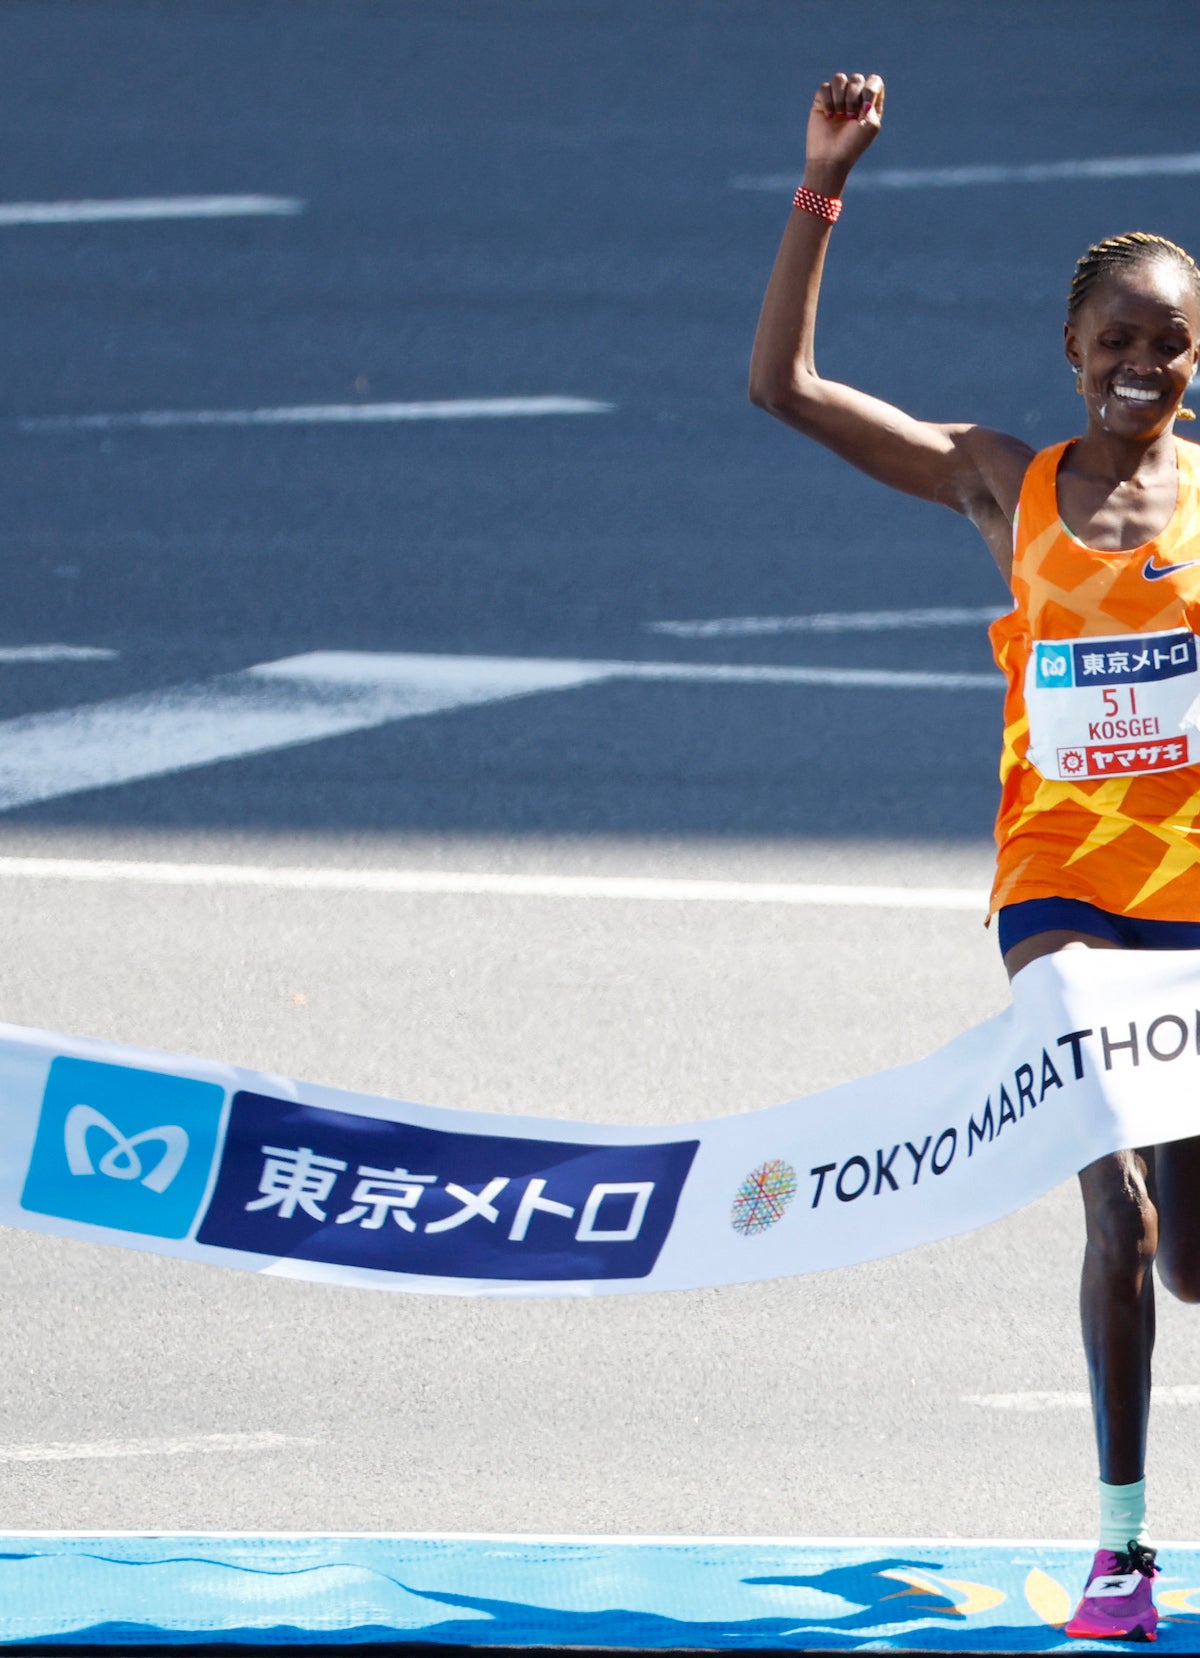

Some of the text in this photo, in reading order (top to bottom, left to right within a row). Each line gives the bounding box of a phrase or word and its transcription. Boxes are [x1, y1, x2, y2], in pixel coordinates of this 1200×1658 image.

[1082, 643, 1189, 676] 東京メトロ
[1102, 687, 1137, 717] 51
[1088, 717, 1160, 740] KOSGEI
[1091, 743, 1183, 769] ヤマザキ
[810, 1127, 957, 1208] TOKYO
[245, 1145, 656, 1242] 東京メトロ
